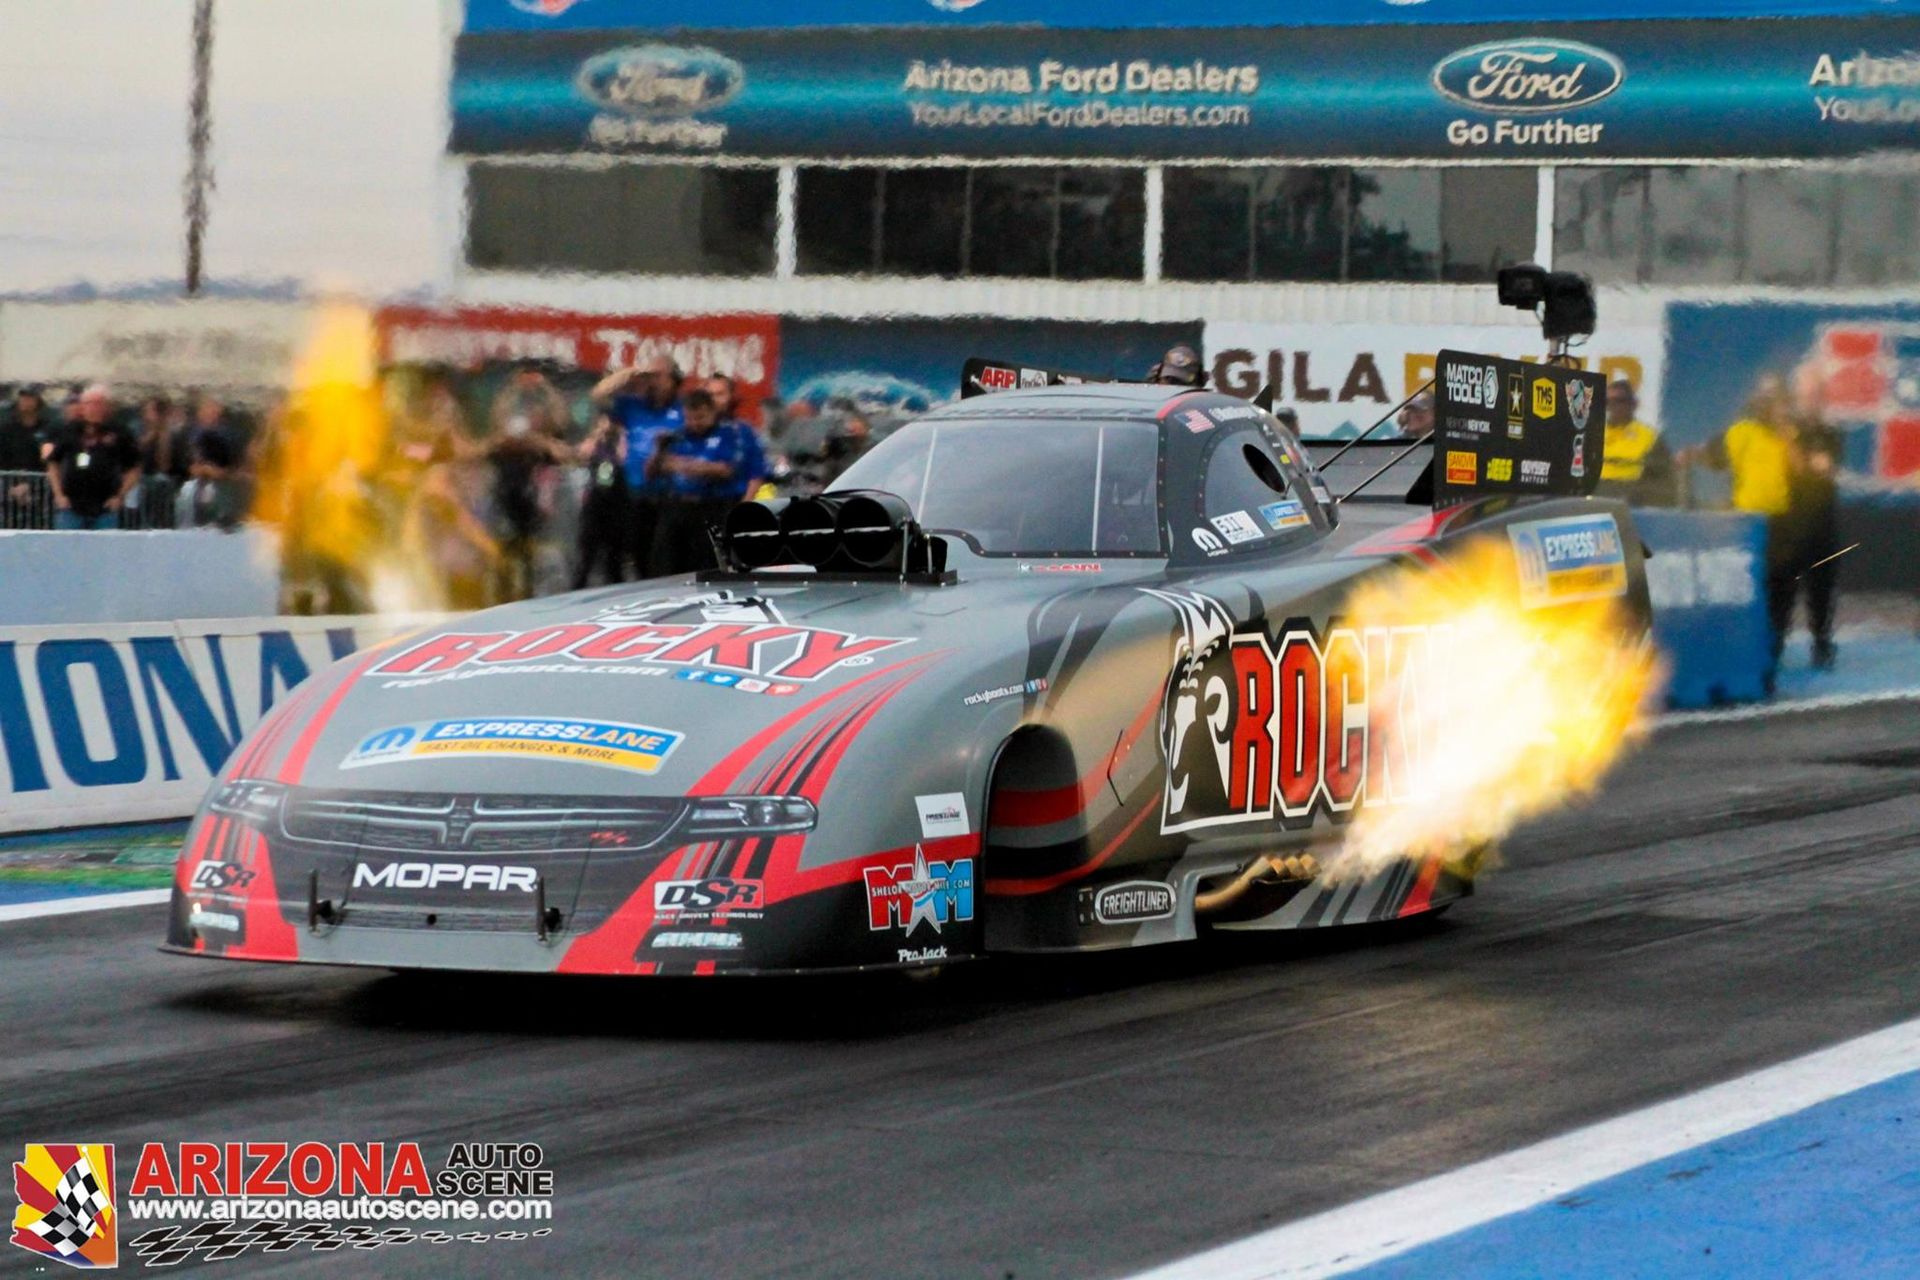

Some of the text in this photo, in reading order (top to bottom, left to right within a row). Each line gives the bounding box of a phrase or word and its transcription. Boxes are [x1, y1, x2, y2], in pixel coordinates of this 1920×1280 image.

[904, 60, 1259, 94] Arizona Ford Dealers
[1467, 51, 1587, 100] Ford
[912, 102, 1250, 128] YourLocalFordDealers.com
[1447, 119, 1603, 145] Go Further
[980, 367, 1017, 389] ARP
[1212, 348, 1391, 402] GILA
[1446, 362, 1483, 385] MATCO
[1446, 381, 1483, 405] TOOLS
[1535, 385, 1553, 405] TMS
[364, 621, 917, 681] ROCKY
[434, 721, 666, 751] EXPRESSLANE
[423, 741, 457, 752] FAST
[487, 741, 555, 754] CHANGES
[573, 745, 617, 760] MORE
[352, 863, 538, 893] MOPAR
[659, 877, 759, 912] DSR
[1103, 890, 1169, 915] FREIGHTLINER
[711, 911, 765, 920] TECHNOLOGY
